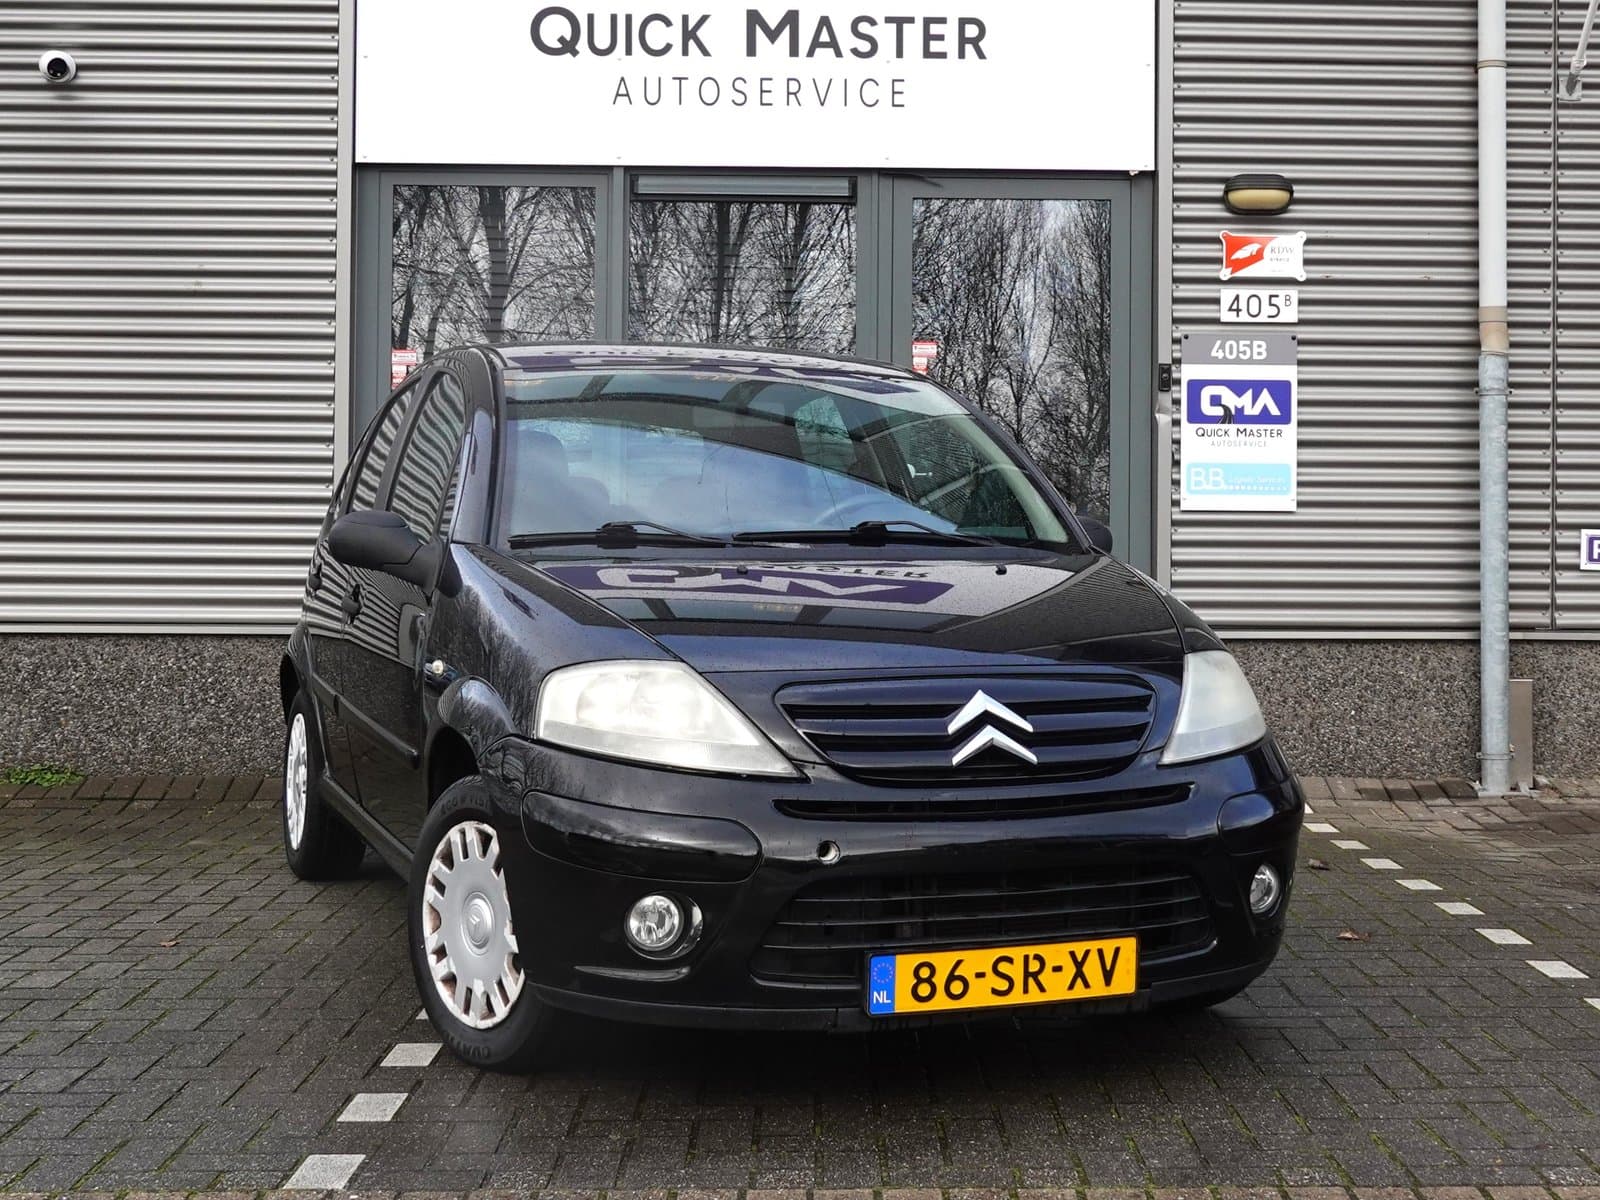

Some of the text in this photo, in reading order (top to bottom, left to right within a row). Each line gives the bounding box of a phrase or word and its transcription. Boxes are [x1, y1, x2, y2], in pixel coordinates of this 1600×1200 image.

[530, 6, 987, 60] QUICK MASTER
[612, 76, 905, 107] AUTOSERVICE
[1210, 340, 1267, 360] 405B
[1195, 427, 1283, 438] QUICK MASTER
[910, 946, 1121, 1003] 86-SR-XV
[873, 990, 892, 1004] NL
